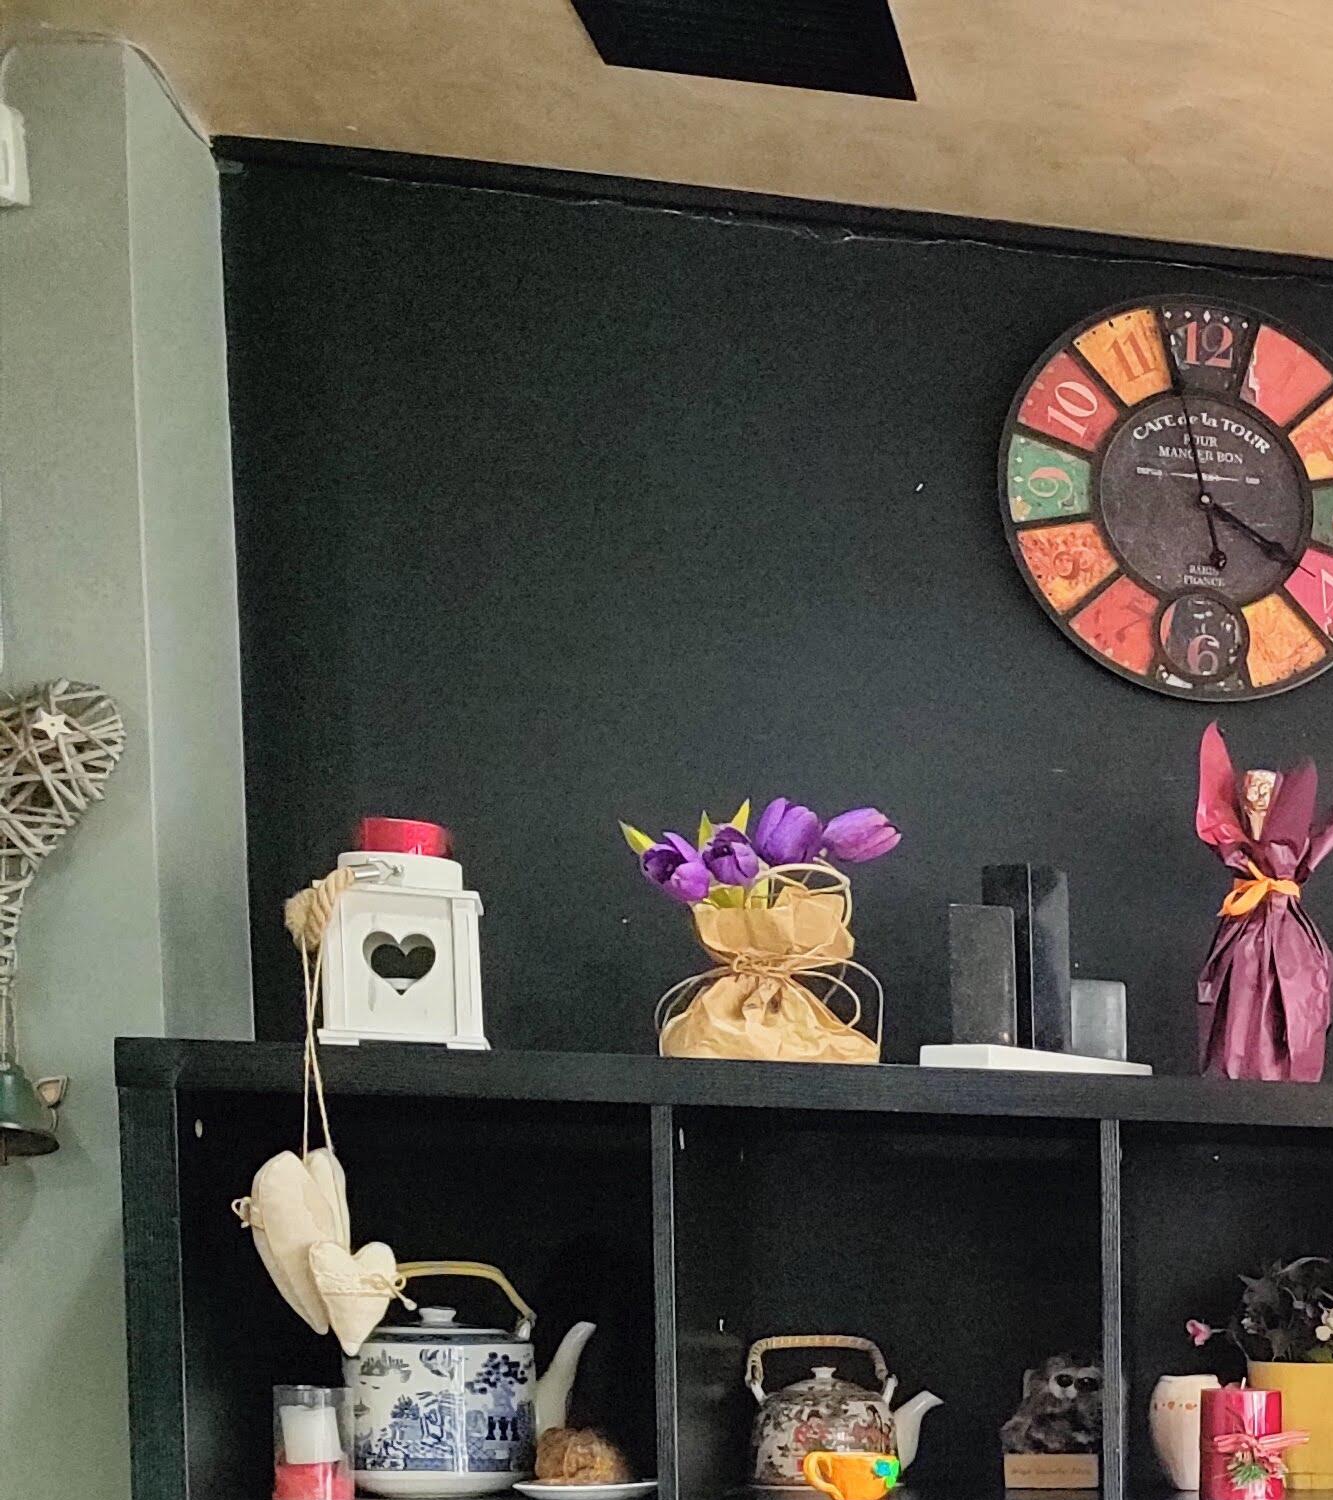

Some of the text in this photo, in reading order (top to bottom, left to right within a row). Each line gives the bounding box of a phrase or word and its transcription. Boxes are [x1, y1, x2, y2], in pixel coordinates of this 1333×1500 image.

[1107, 331, 1157, 382] 11
[1184, 321, 1233, 368] 12
[1047, 381, 1098, 438] 10
[1201, 412, 1218, 428] la
[1221, 418, 1271, 454] TOUR
[1217, 450, 1243, 465] BON
[1027, 467, 1074, 509] 9
[1187, 634, 1220, 676] 6
